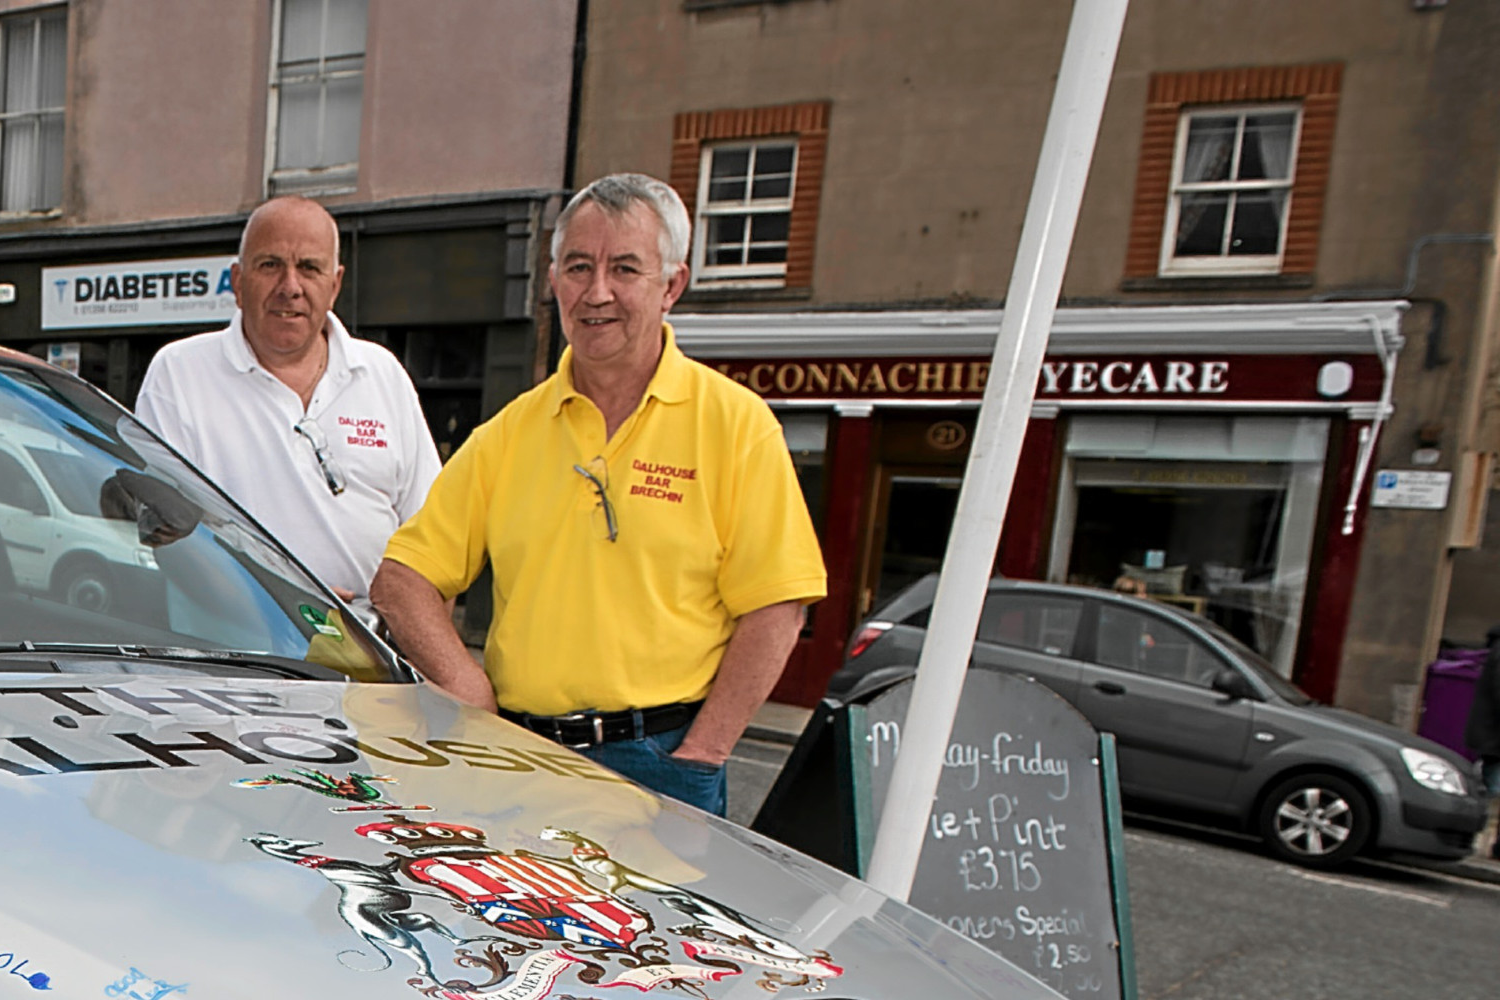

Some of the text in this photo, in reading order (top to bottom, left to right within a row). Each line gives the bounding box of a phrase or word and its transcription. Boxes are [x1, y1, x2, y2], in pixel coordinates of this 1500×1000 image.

[75, 270, 209, 302] DIABETES
[1040, 361, 1230, 394] YECARE
[356, 427, 376, 437] BAR
[645, 475, 671, 489] BAR
[629, 485, 683, 504] BRECHIN
[959, 845, 1042, 892] £3.75
[645, 966, 676, 978] ET
